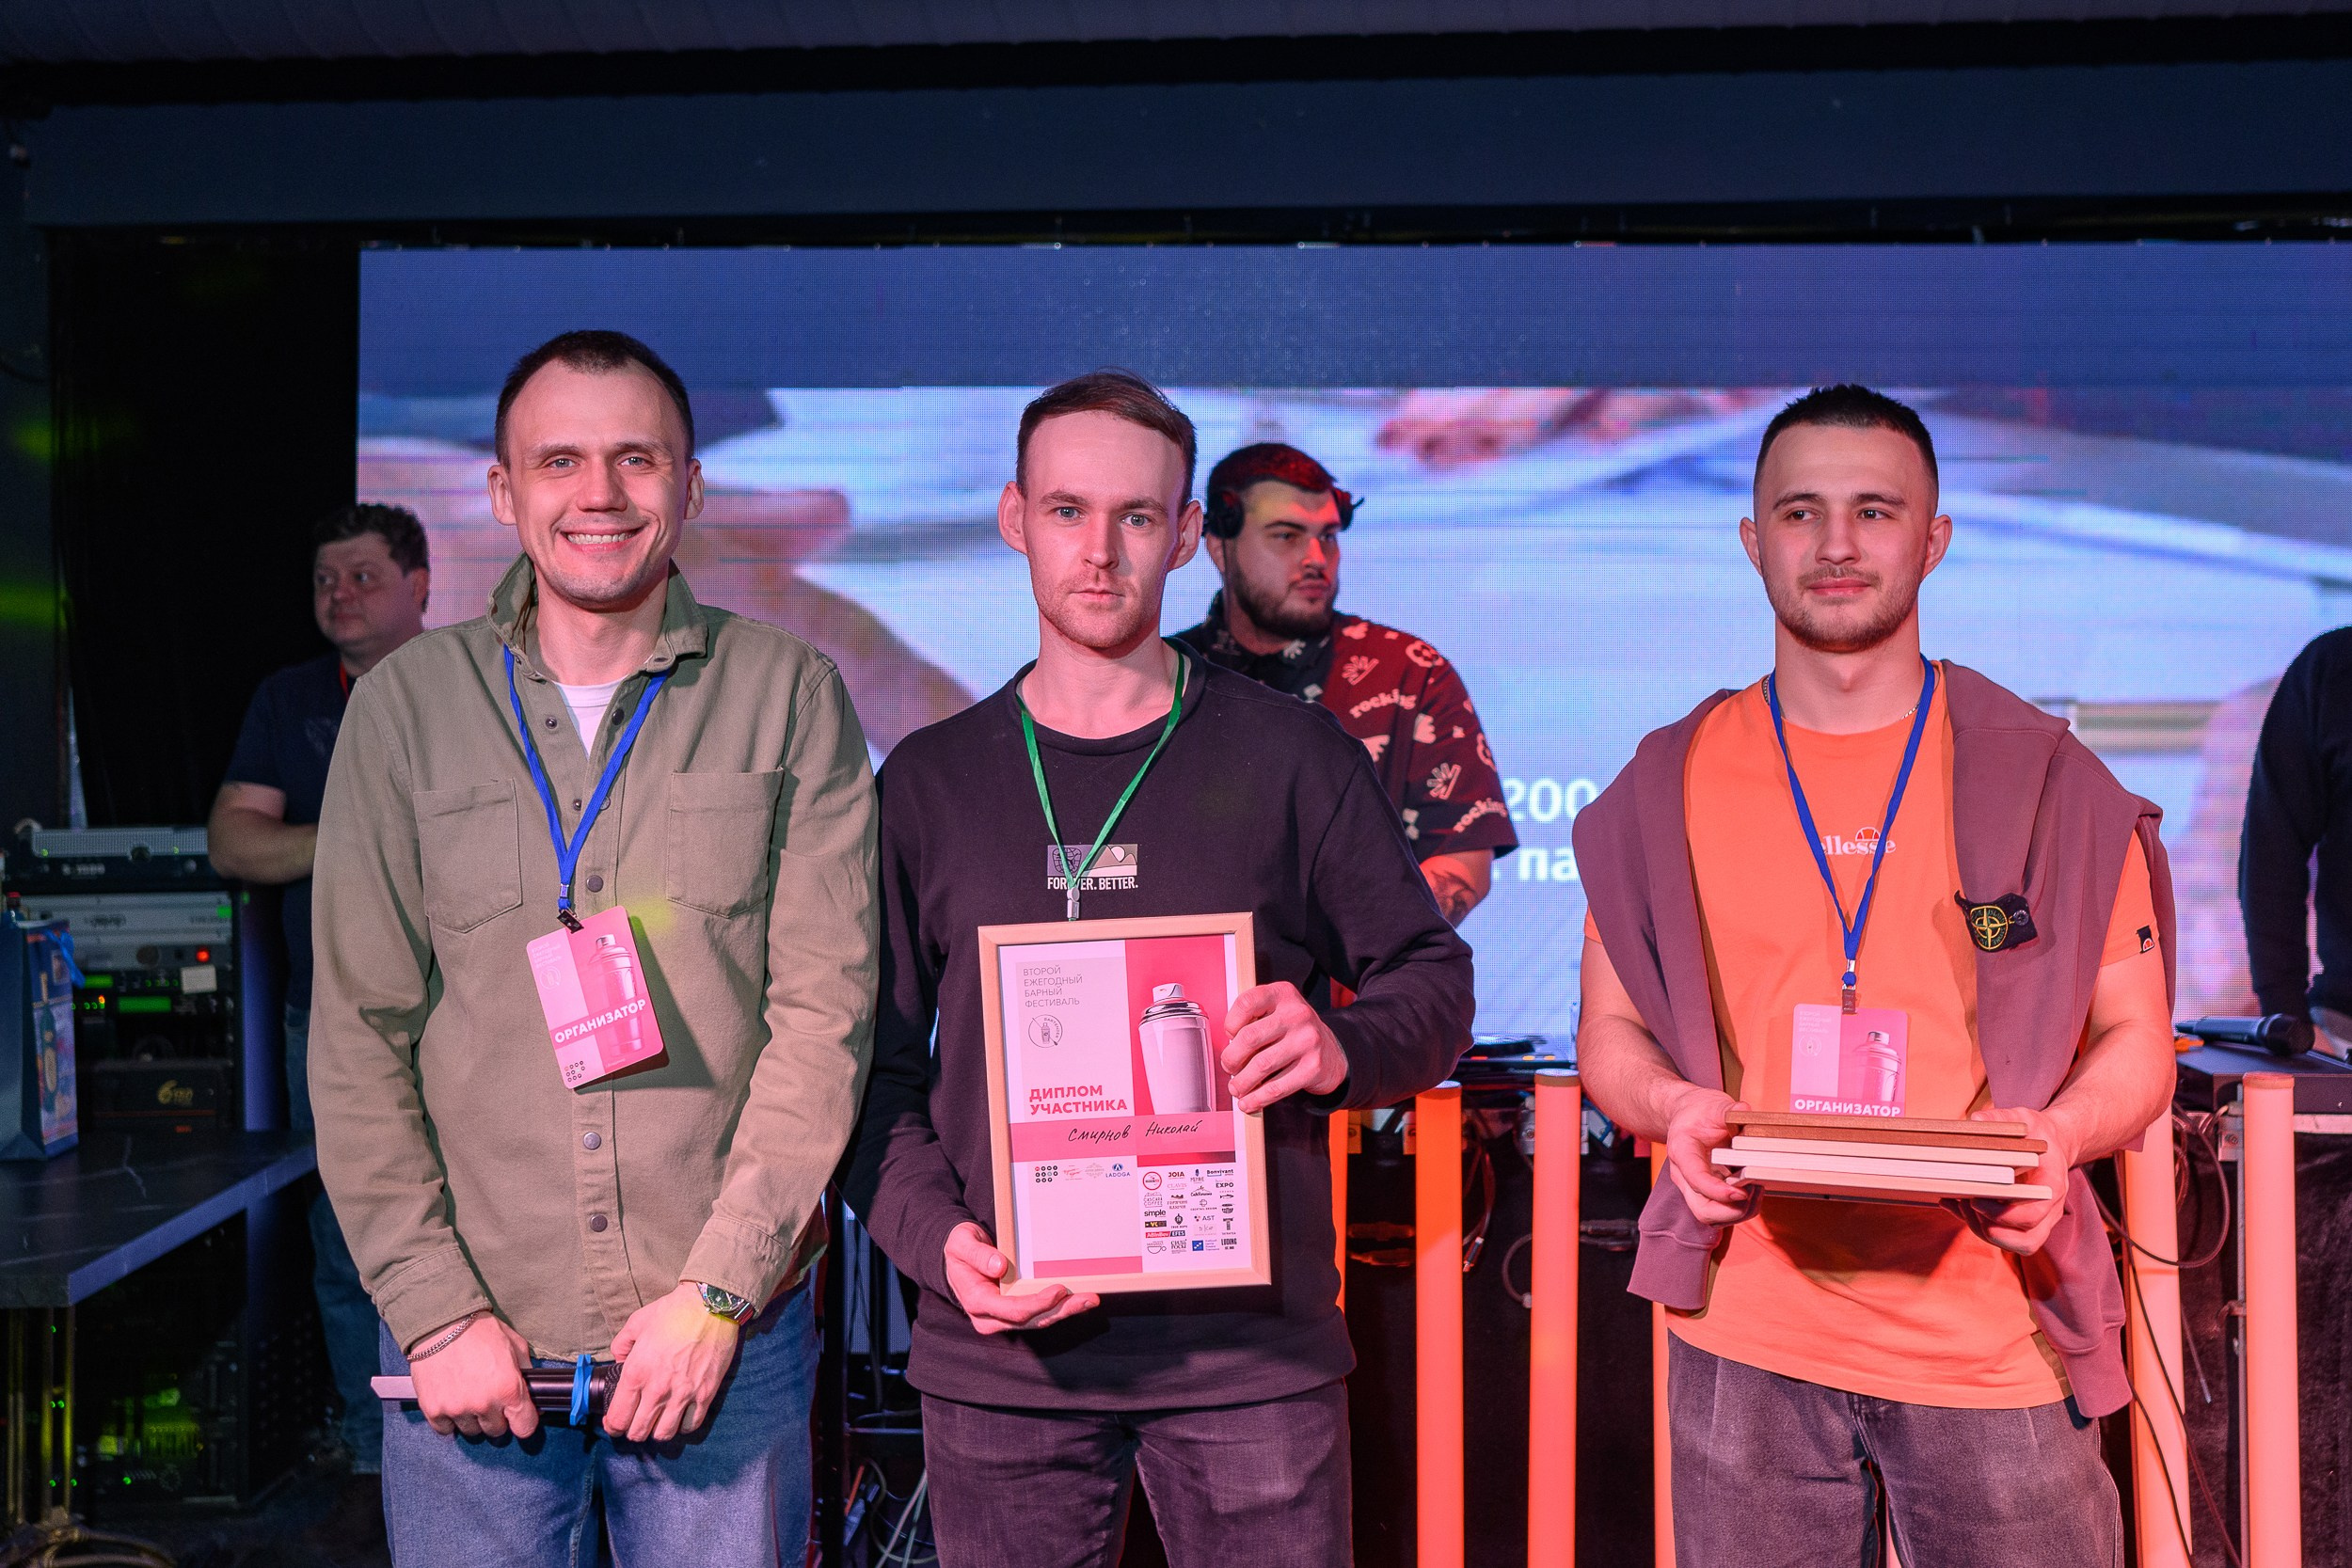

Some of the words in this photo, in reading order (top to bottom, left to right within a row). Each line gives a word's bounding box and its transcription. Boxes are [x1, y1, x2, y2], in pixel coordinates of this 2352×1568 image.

[1099, 877, 1138, 890] BETTER.
[1024, 964, 1061, 975] ВТОРОЙ
[1024, 974, 1083, 987] ЕЖЕГОДНЫЙ
[1025, 986, 1062, 997] БАРНЫЙ
[1025, 998, 1080, 1007] ФЕСТИВАЛЬ
[554, 999, 646, 1043] ОРГАНИЗАТОР
[1029, 1085, 1103, 1102] ДИПЛОМ
[1030, 1099, 1127, 1116] УЧАСТНИКА
[1794, 1099, 1900, 1117] ОРГАНИЗАТОР
[1068, 1124, 1131, 1144] Смирнов
[1145, 1119, 1202, 1137] Николай
[1144, 1209, 1167, 1217] simple
